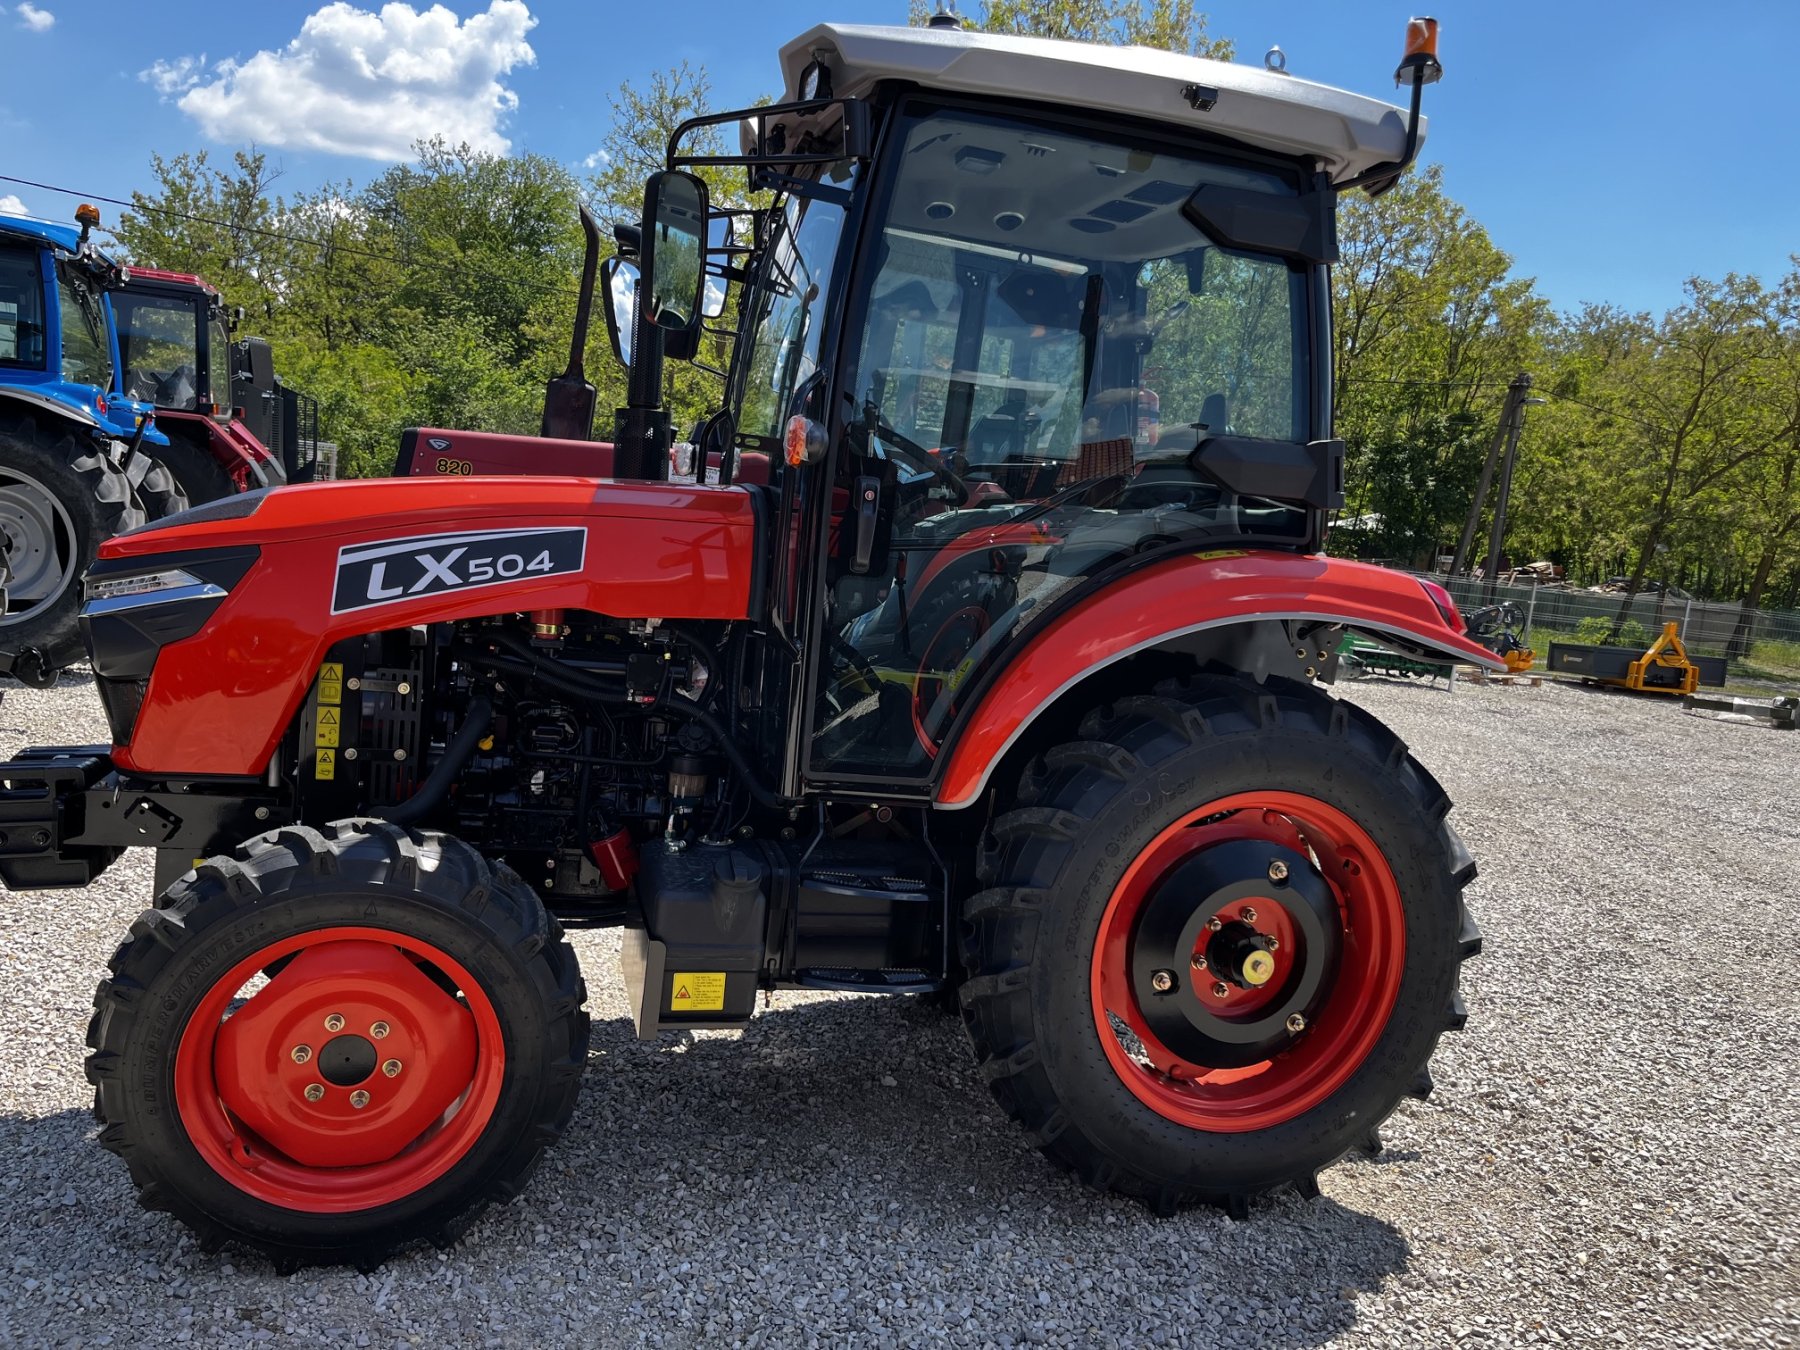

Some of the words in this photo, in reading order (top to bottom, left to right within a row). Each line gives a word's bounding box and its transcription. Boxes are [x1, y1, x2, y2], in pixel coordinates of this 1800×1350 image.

[436, 458, 473, 476] 820
[143, 1010, 171, 1103] BUMPER
[171, 924, 257, 999] HARVEST
